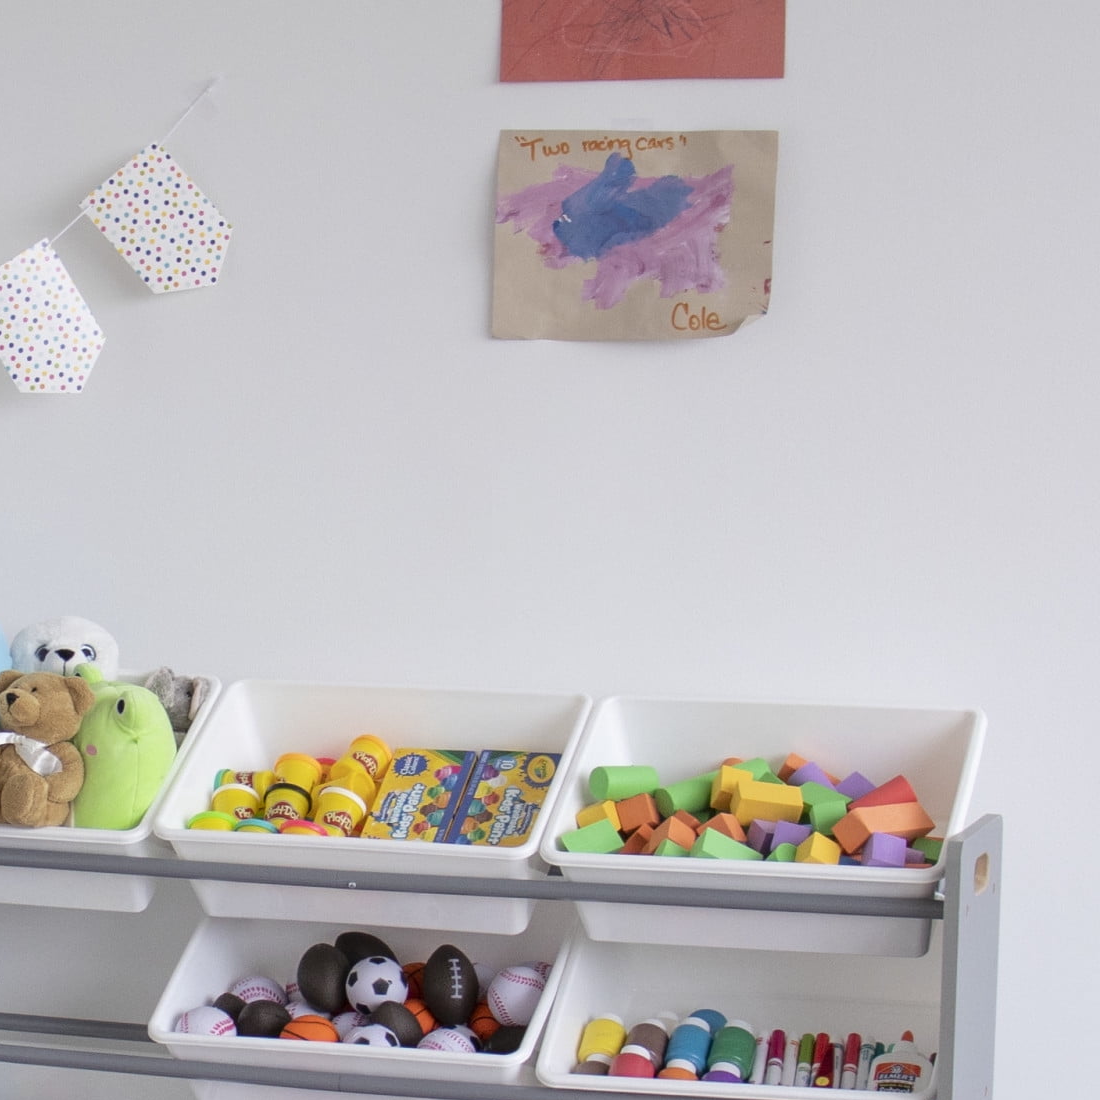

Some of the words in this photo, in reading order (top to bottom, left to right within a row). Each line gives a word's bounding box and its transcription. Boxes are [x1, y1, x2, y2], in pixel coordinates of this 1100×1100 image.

[582, 136, 633, 159] racing
[671, 302, 728, 331] Cole
[402, 783, 426, 813] Paint
[487, 814, 511, 845] Paint
